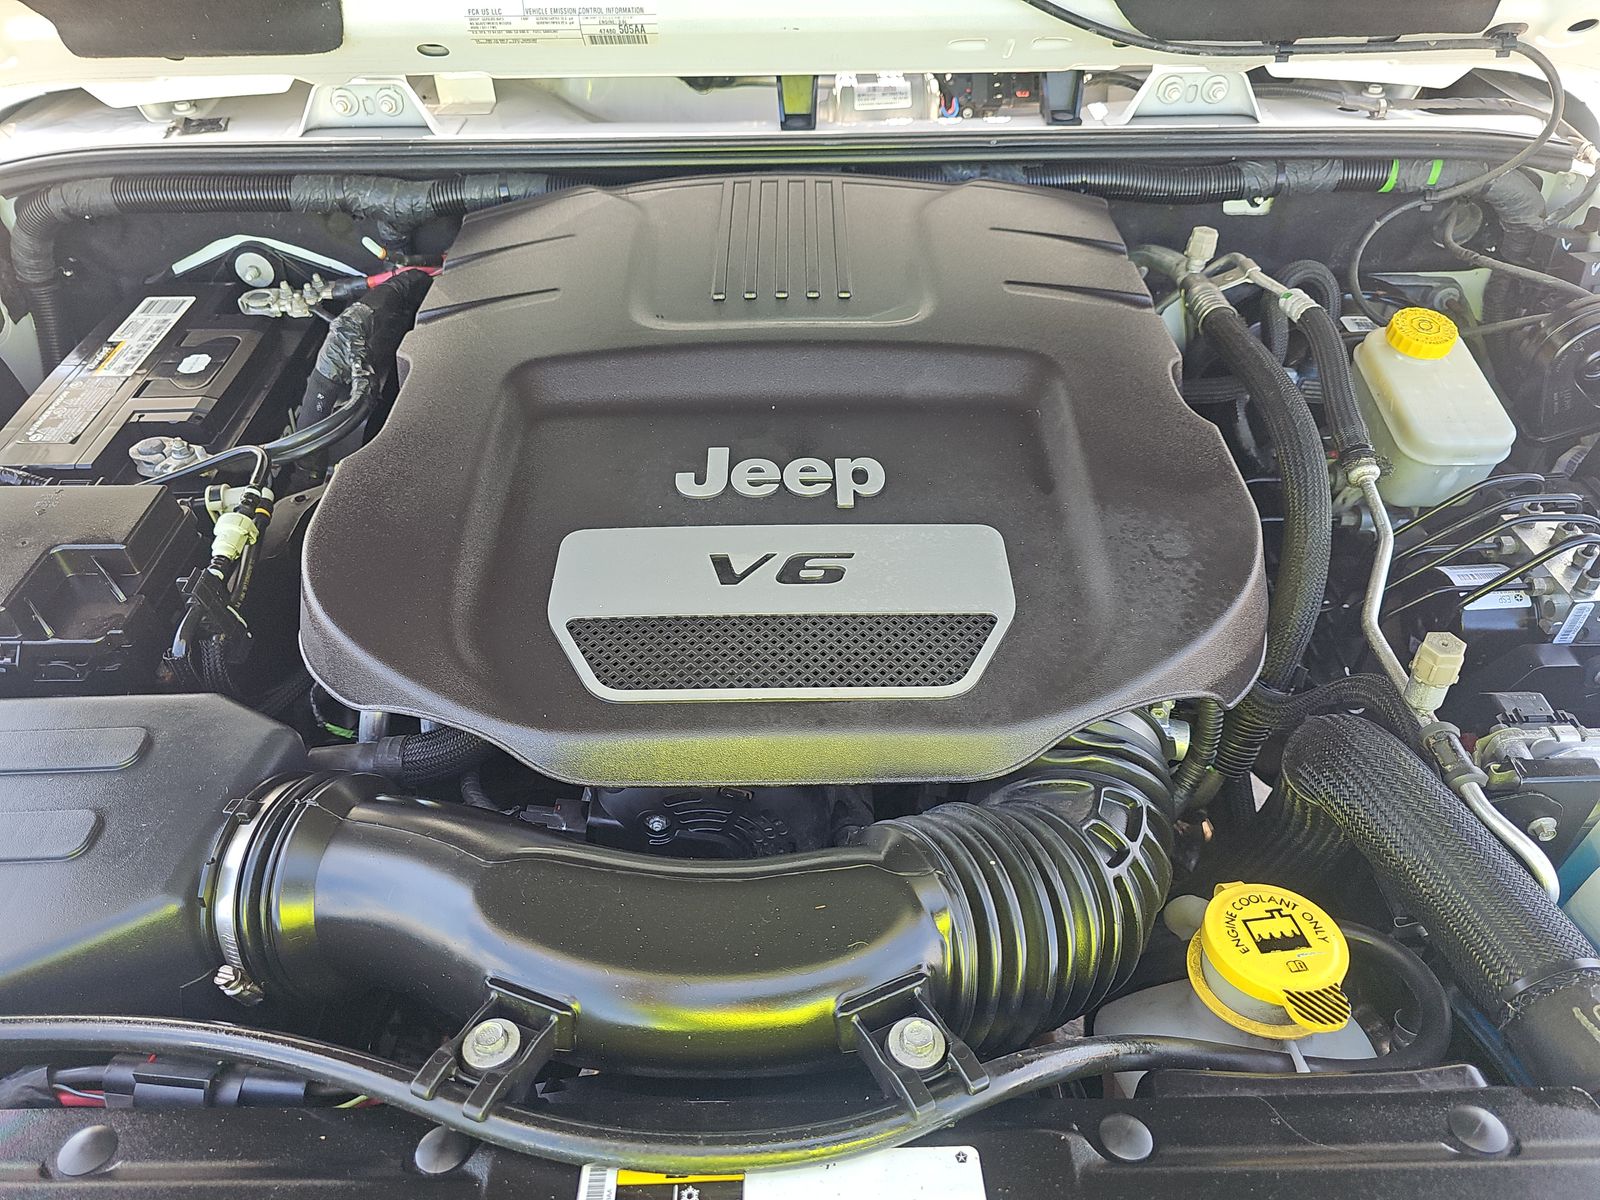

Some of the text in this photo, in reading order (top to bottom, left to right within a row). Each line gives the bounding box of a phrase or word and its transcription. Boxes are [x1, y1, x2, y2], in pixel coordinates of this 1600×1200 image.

[467, 8, 502, 16] FCA US LLC
[549, 7, 576, 15] EMISSION
[578, 7, 604, 15] CONTROL
[606, 6, 644, 14] INFORMATION
[618, 24, 646, 34] 505AA
[675, 447, 886, 508] Jeep
[709, 553, 855, 585] V6
[1225, 894, 1329, 954] ENGINE COOLANT ONLY
